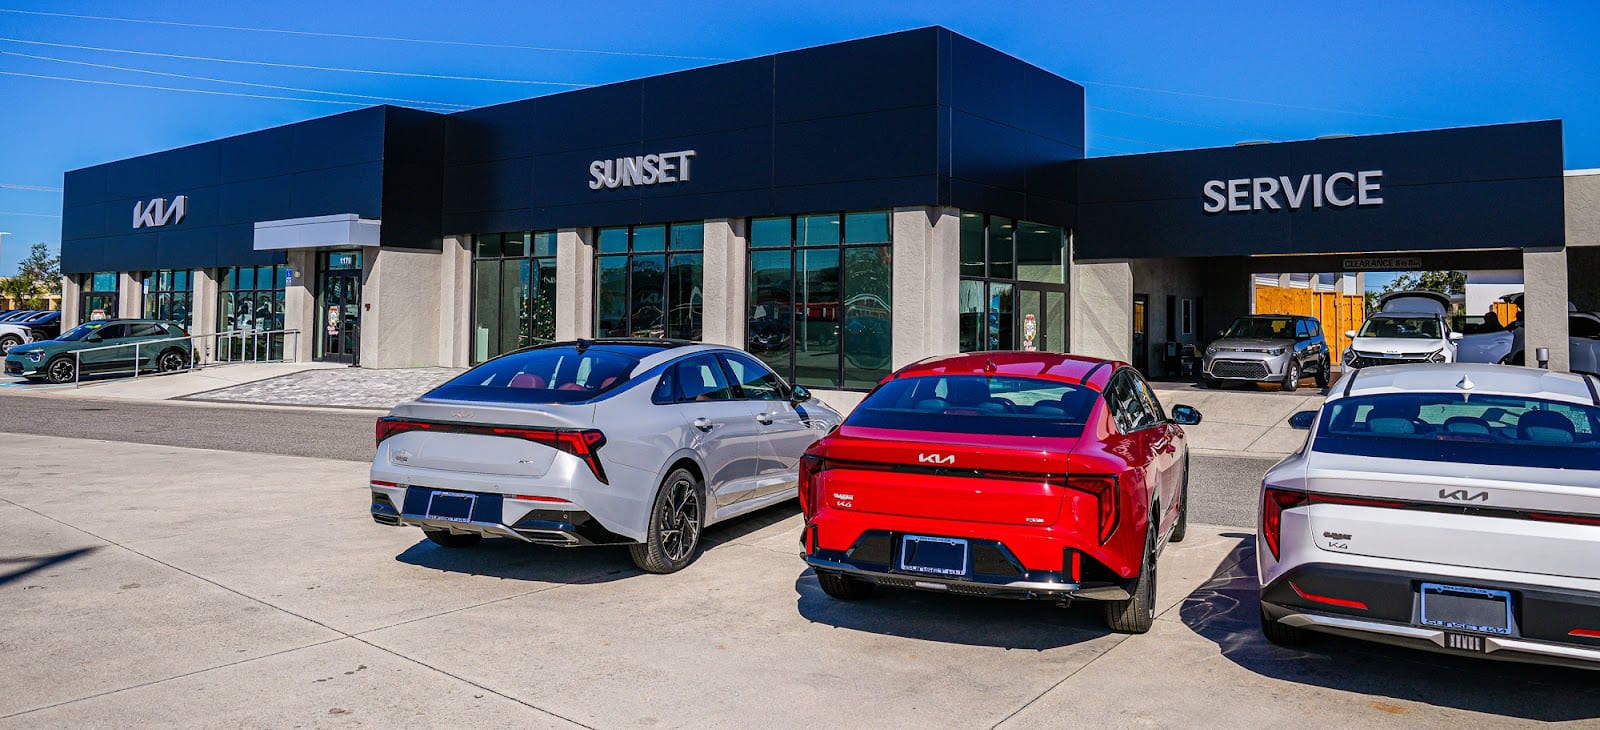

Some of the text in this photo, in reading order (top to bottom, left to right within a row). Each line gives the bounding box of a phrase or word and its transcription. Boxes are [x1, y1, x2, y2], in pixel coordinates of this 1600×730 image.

[588, 150, 696, 190] SUNSET
[1203, 169, 1384, 214] SERVICE
[132, 195, 188, 229] KIA
[1344, 259, 1393, 268] CLEARANCE
[918, 453, 956, 465] KIA
[1439, 488, 1489, 502] KIA
